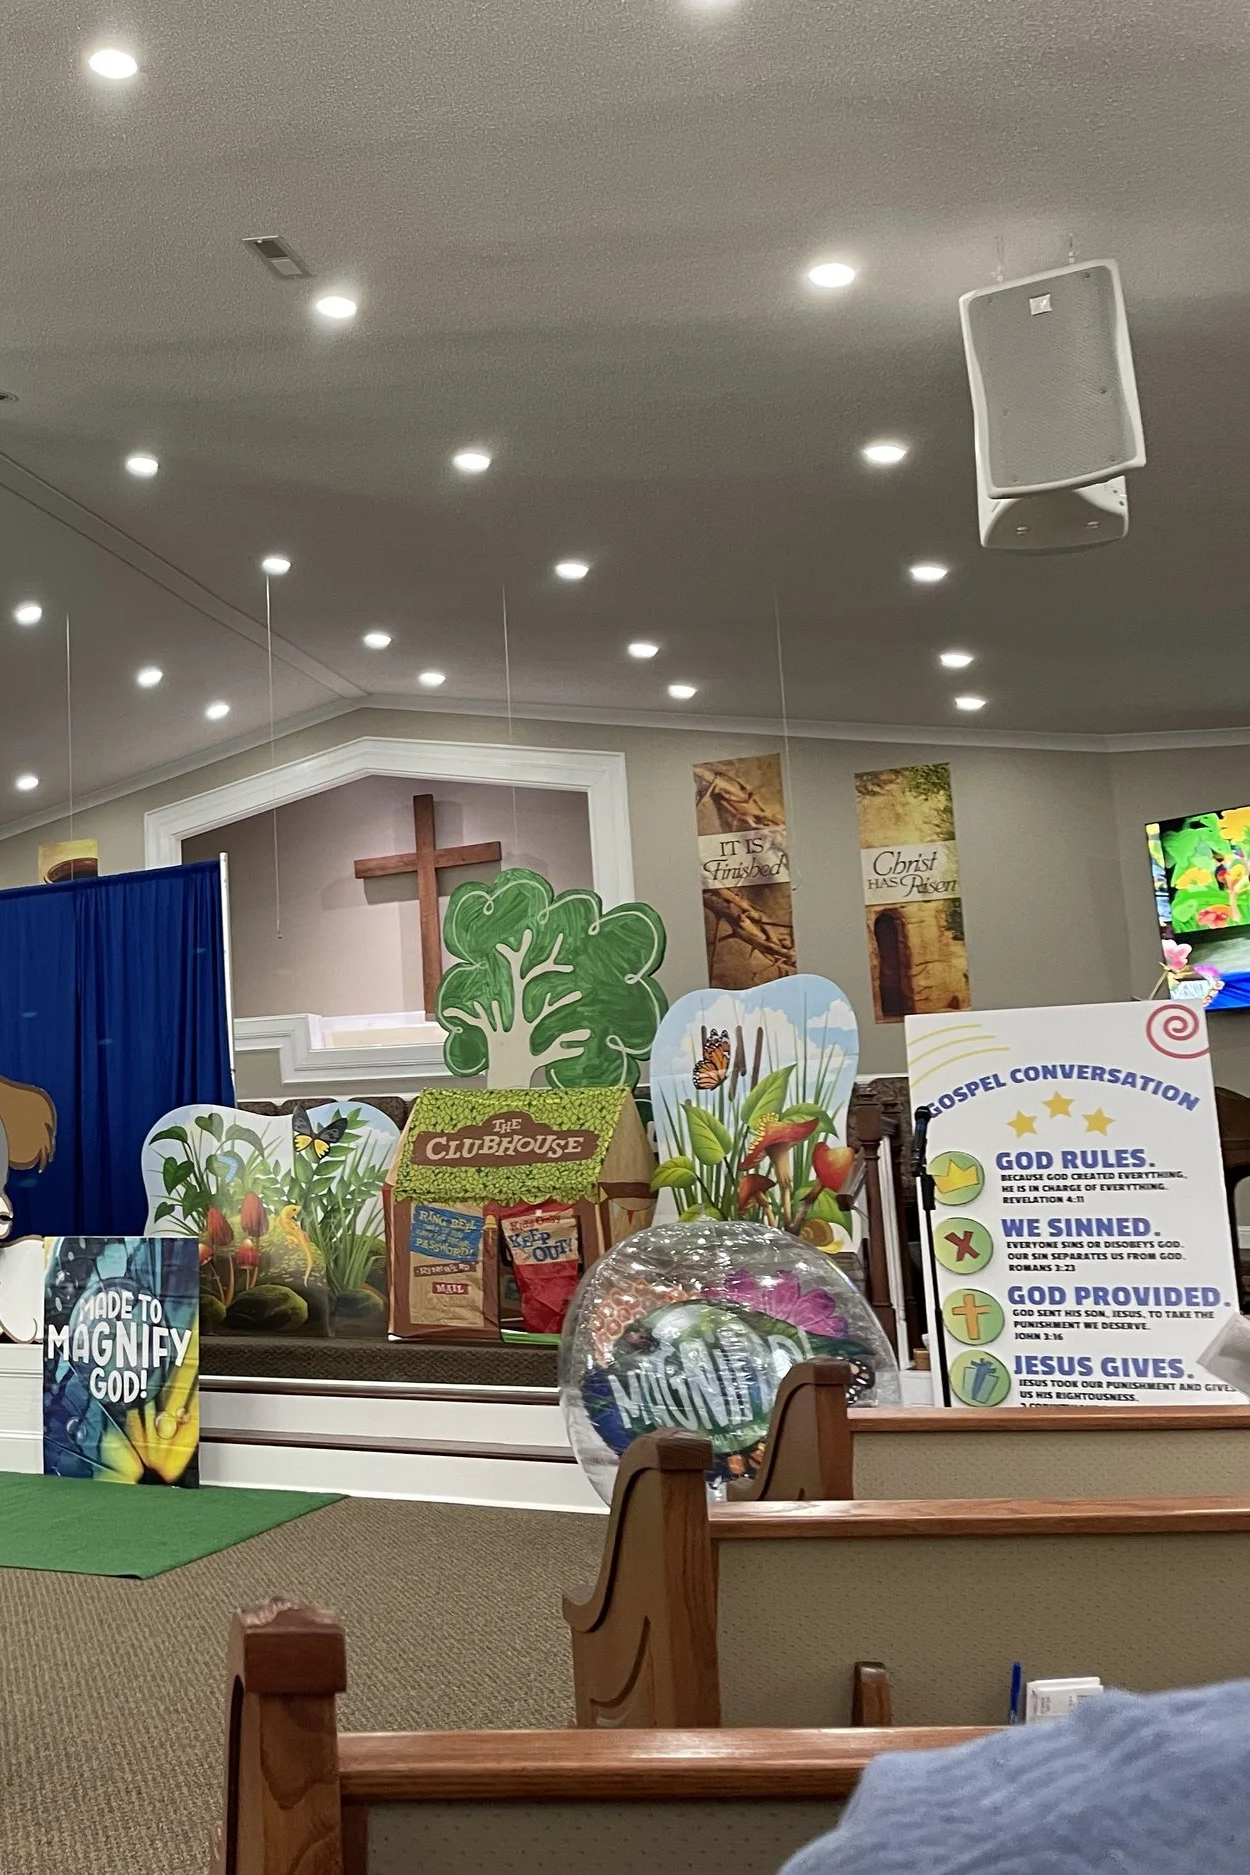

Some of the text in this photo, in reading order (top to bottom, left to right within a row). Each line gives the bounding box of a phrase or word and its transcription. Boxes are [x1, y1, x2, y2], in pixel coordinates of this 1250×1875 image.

[720, 838, 764, 856] IT IS
[703, 854, 784, 880] Finished
[873, 851, 938, 877] Christ
[868, 873, 957, 898] HAS Risen
[928, 1064, 1201, 1119] GOSPEL CONVERSATION
[492, 1118, 522, 1133] THE
[425, 1135, 584, 1160] CLUBHOUSE
[995, 1149, 1156, 1171] GOD RULES.
[1001, 1174, 1044, 1182] BECAUSE
[1047, 1173, 1068, 1181] GOD
[1071, 1172, 1115, 1180] CREATED
[1042, 1184, 1082, 1192] CHARGE
[508, 1228, 551, 1249] KEEP
[1001, 1218, 1161, 1237] WE SINNED.
[533, 1238, 572, 1262] OUT!
[436, 1284, 464, 1294] MAIL
[1008, 1286, 1231, 1307] GOD PROVIDED.
[82, 1291, 162, 1324] MADE TO
[1014, 1321, 1081, 1329] PUNISHMENT
[48, 1321, 192, 1368] MAGNIFY
[1014, 1355, 1194, 1379] JESUS GIVES.
[90, 1367, 147, 1402] GOD!
[1019, 1379, 1048, 1387] JESUS
[1051, 1380, 1078, 1388] TOOK
[1106, 1382, 1175, 1390] PUNISHMENT
[1179, 1383, 1201, 1391] AND
